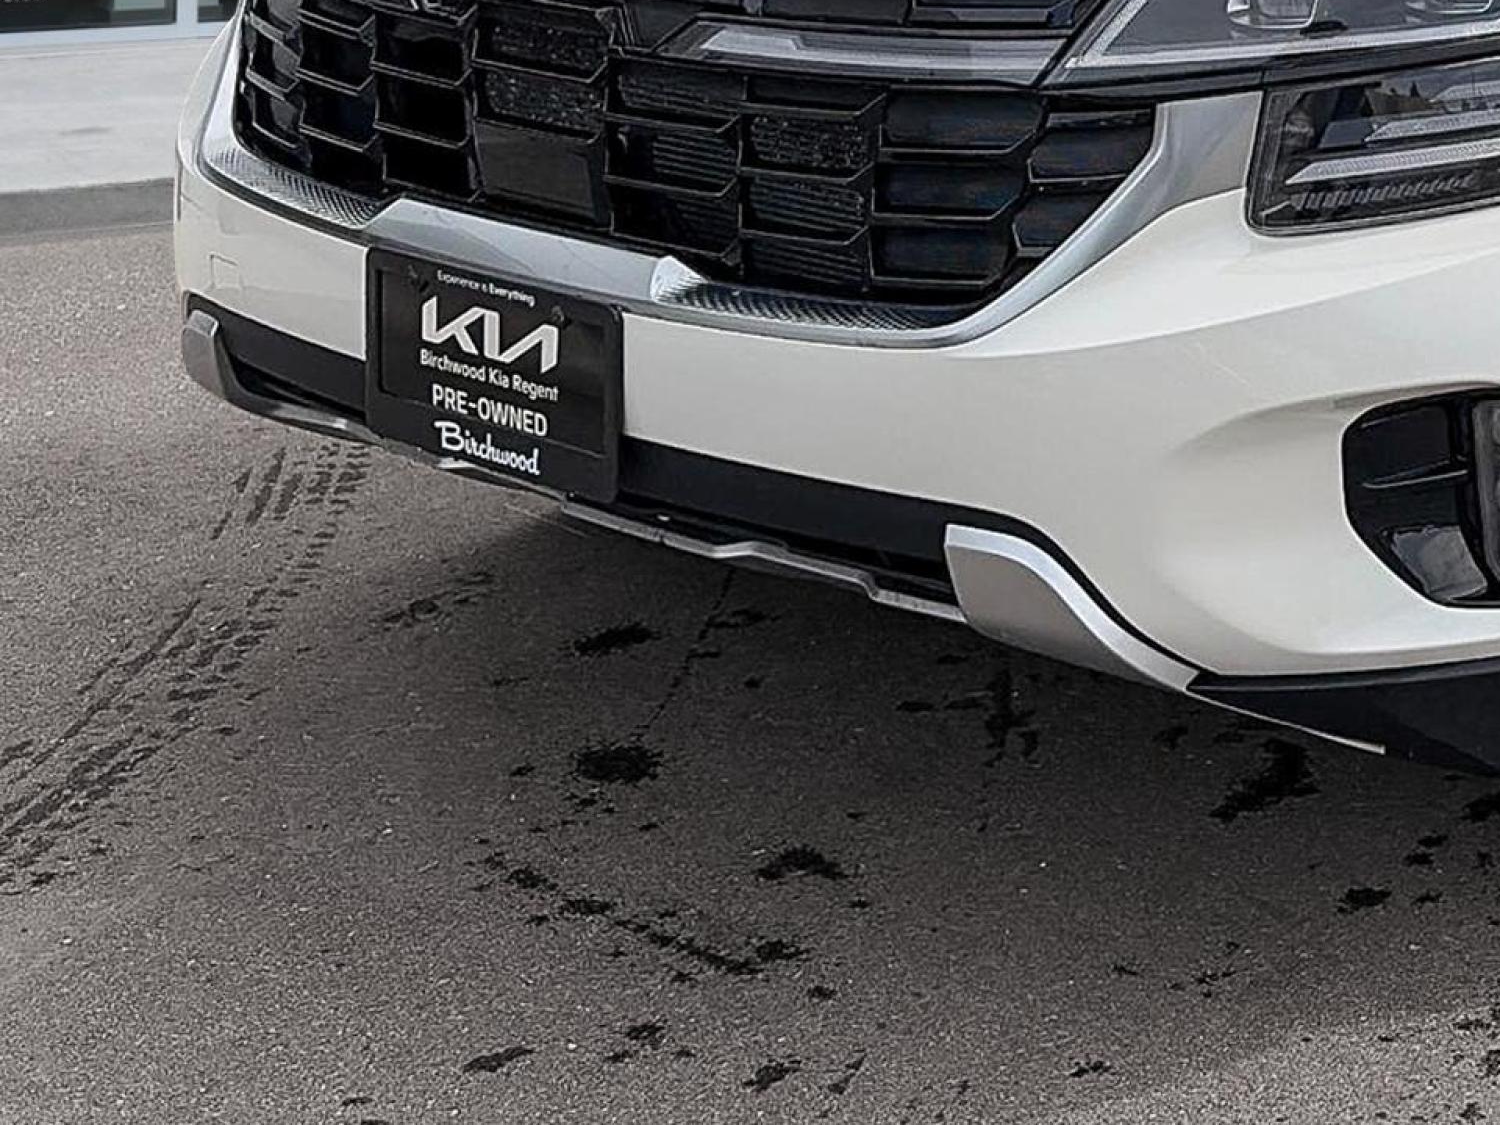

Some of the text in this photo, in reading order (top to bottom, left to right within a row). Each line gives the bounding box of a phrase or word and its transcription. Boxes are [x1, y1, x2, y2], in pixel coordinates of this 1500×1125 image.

[422, 295, 558, 373] KIA
[420, 348, 559, 401] Birchwood Kia Regent
[432, 383, 548, 436] PRE-OWNED
[434, 421, 541, 475] Birchwood
